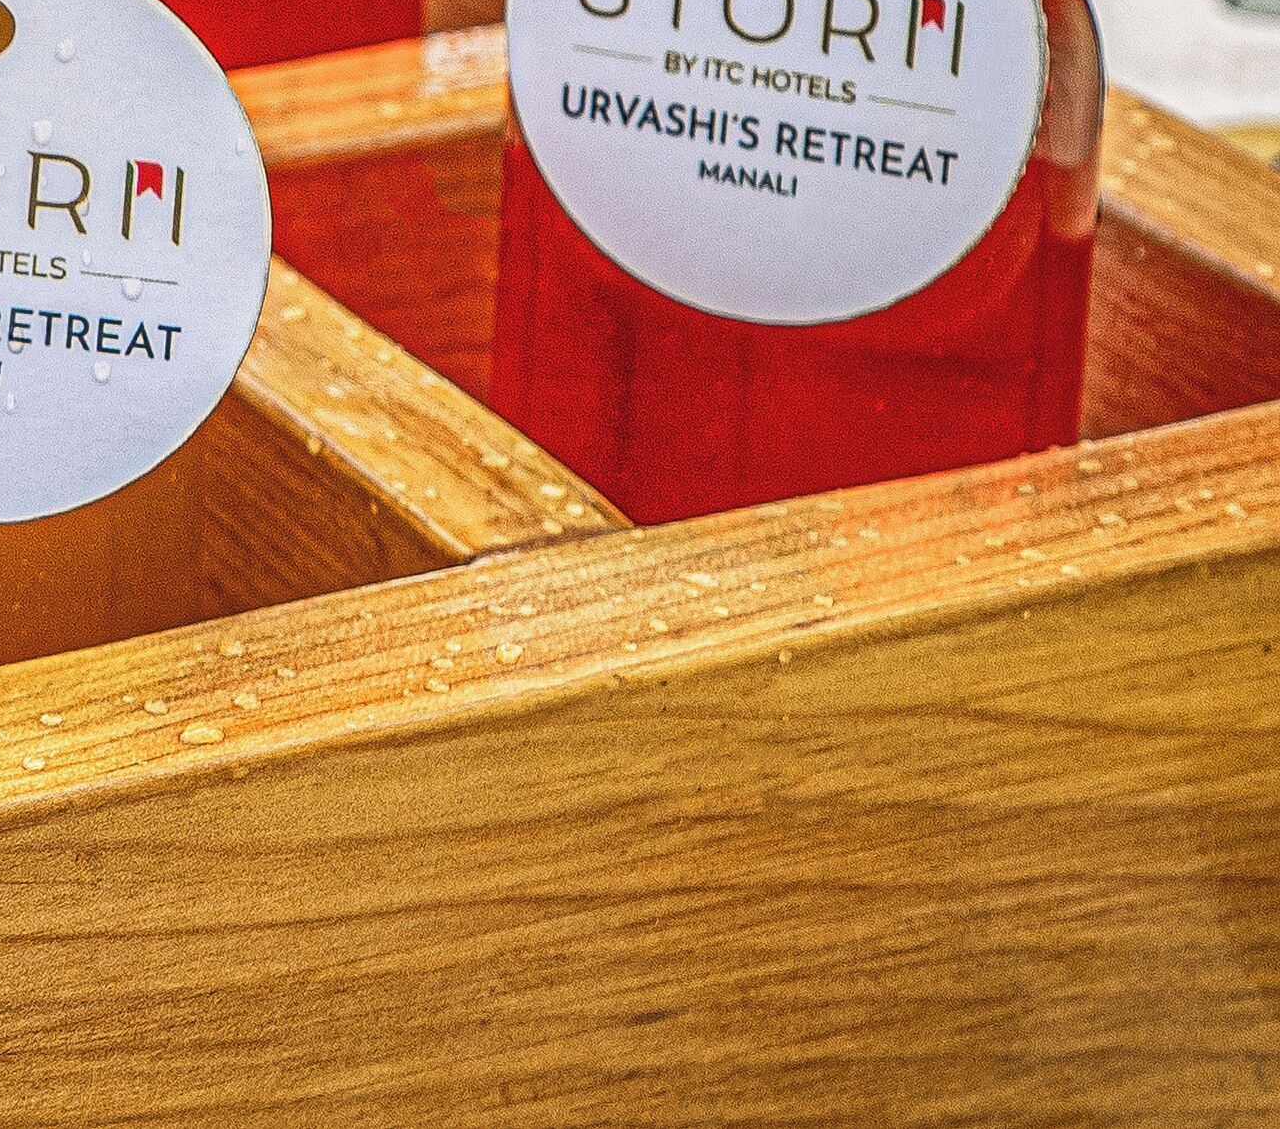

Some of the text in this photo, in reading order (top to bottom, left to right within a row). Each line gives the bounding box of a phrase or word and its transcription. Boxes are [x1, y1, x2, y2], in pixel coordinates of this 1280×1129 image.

[664, 50, 857, 104] BY ITC HOTELS
[561, 81, 959, 185] URVASHI'S RETREAT
[698, 159, 799, 198] MANALI
